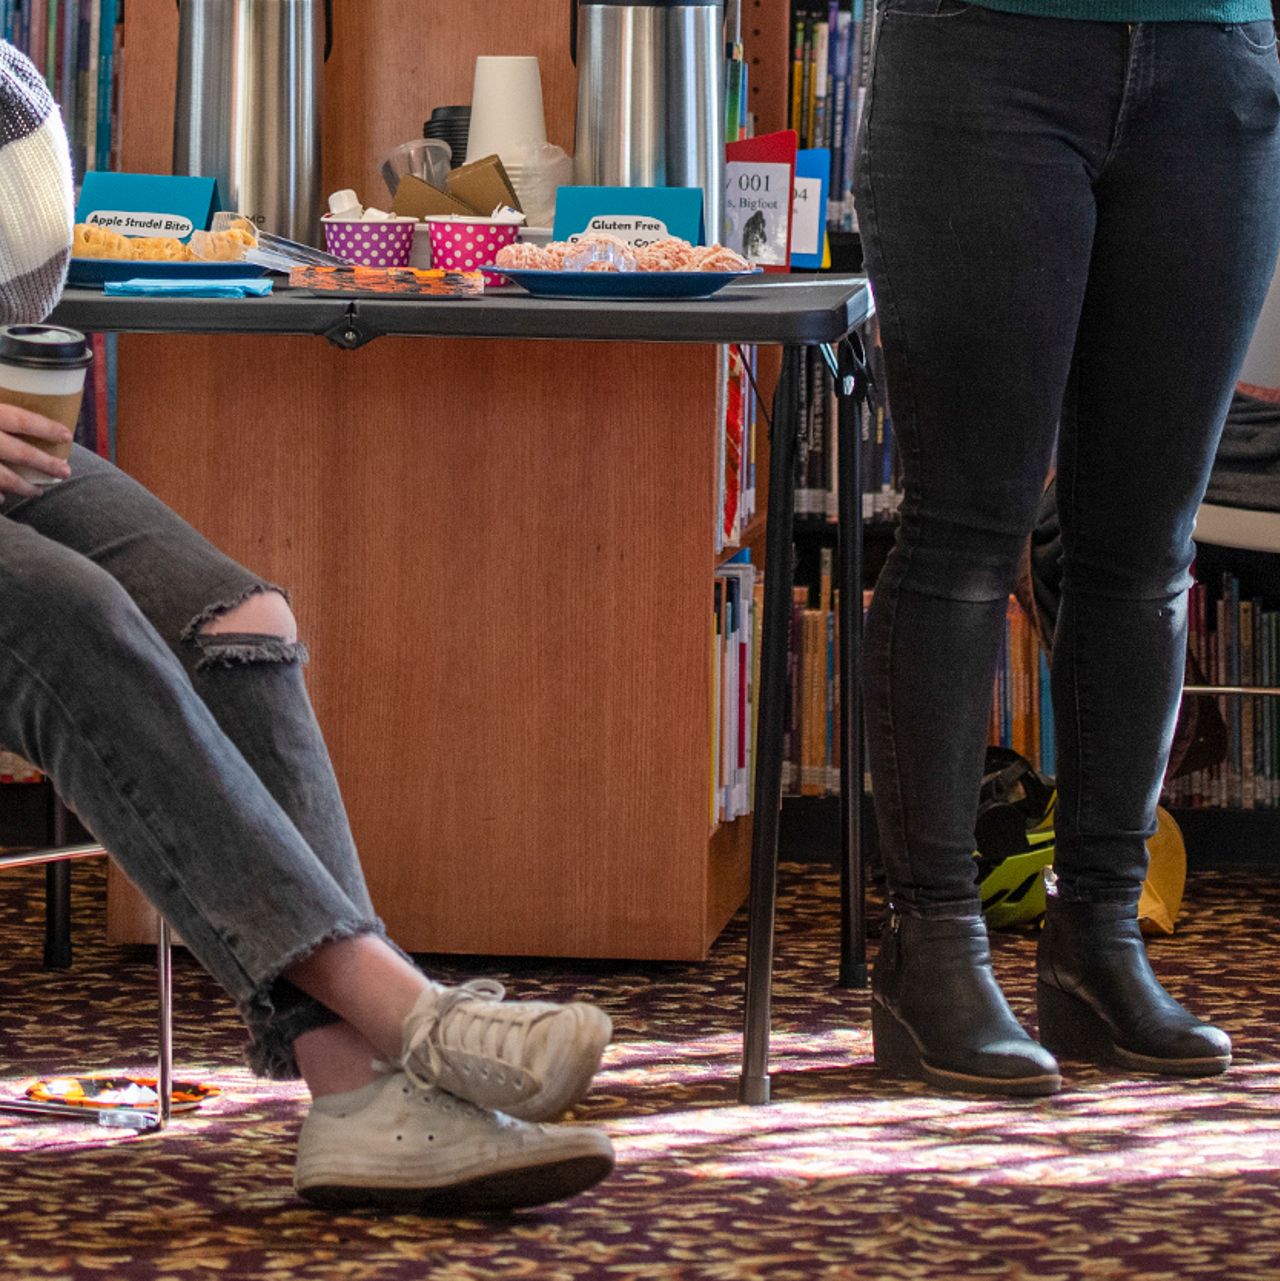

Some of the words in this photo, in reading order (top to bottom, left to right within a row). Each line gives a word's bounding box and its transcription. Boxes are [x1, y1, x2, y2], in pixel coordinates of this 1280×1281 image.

[738, 174, 771, 192] 001
[739, 198, 779, 211] Bigfoot
[90, 214, 122, 227] Apple
[125, 217, 163, 230] Strudel
[165, 221, 191, 232] Bites
[591, 220, 632, 231] Gluten
[635, 220, 661, 231] Free
